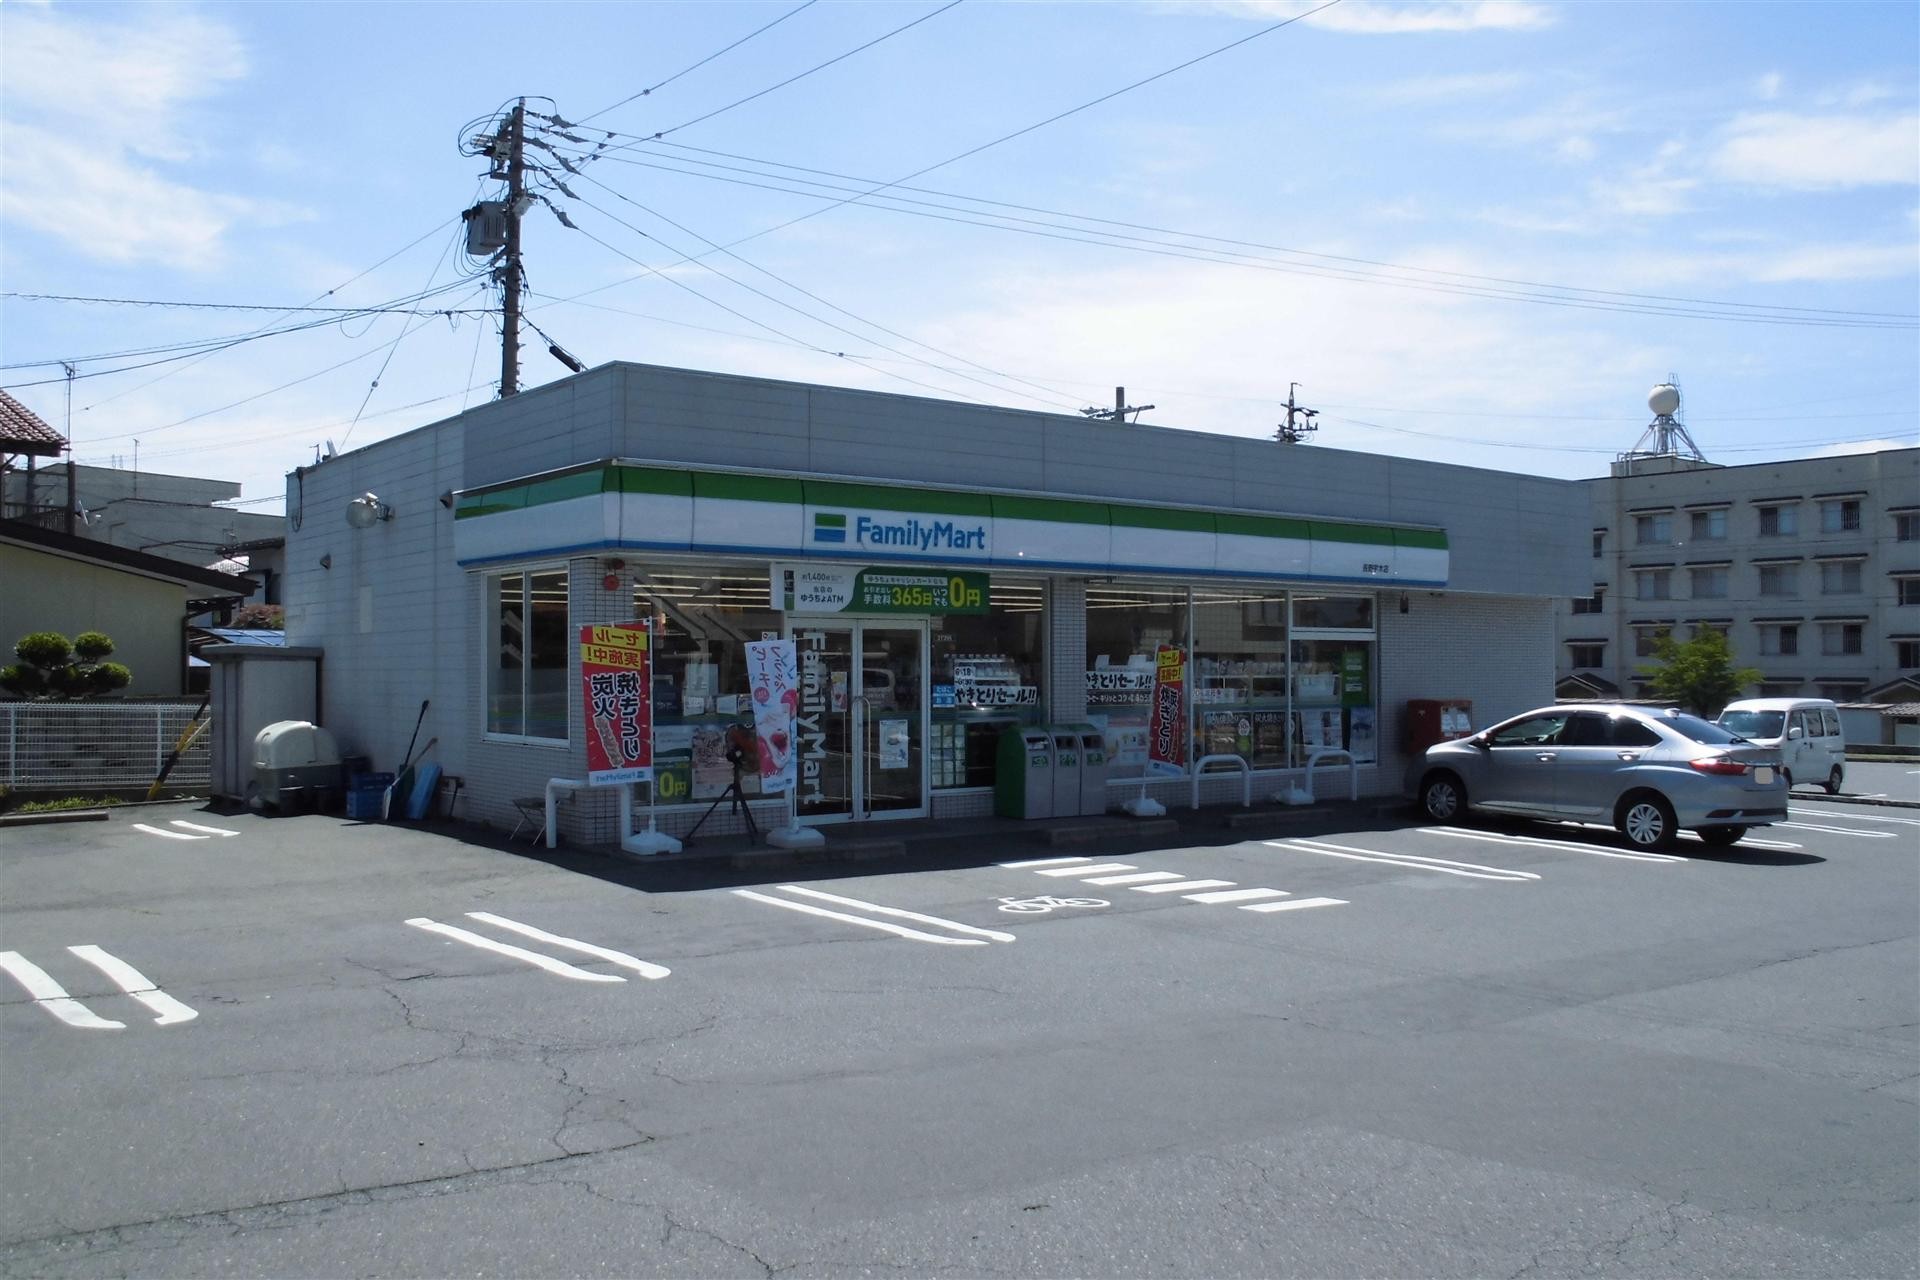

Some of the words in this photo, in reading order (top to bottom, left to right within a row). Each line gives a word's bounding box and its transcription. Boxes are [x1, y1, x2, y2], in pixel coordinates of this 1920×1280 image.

[856, 516, 985, 551] FamilyMart
[800, 594, 844, 603] ゆうちょATM
[892, 586, 932, 606] 365日
[949, 576, 981, 608] 0円
[955, 686, 1036, 704] やきとりセール!!
[797, 632, 826, 805] FamilyMart
